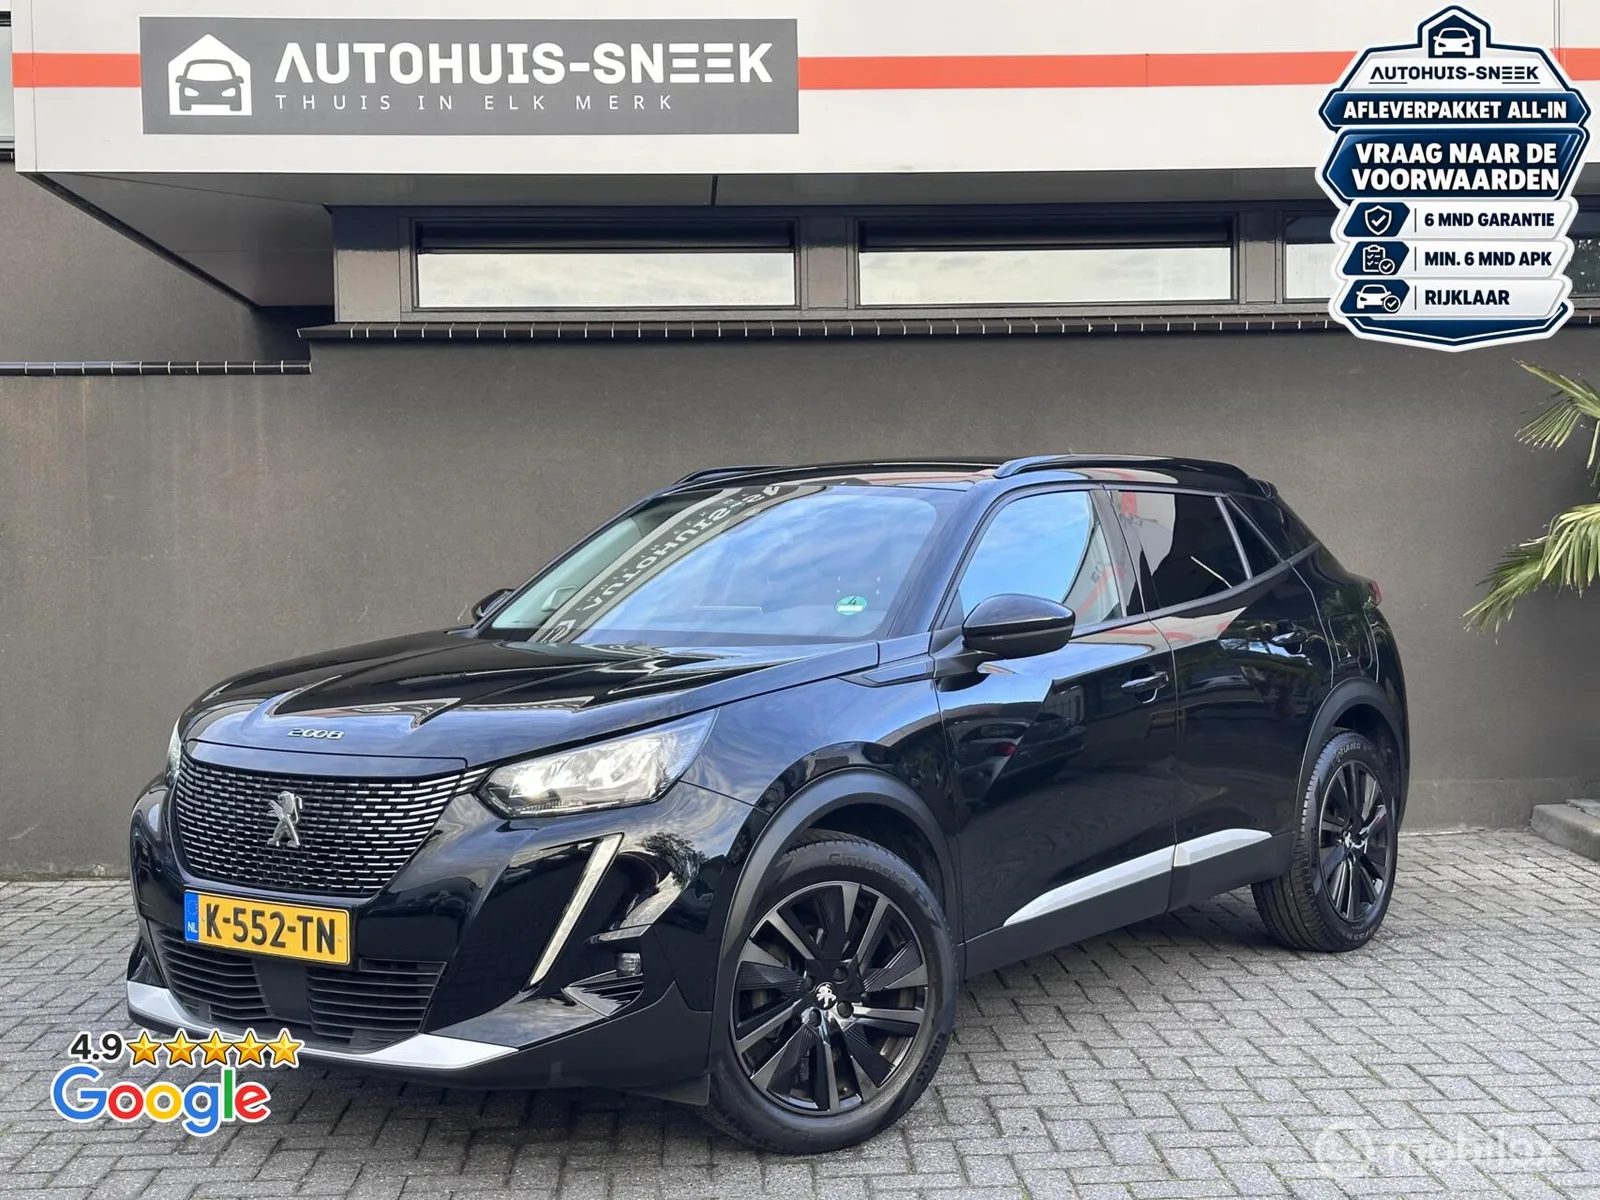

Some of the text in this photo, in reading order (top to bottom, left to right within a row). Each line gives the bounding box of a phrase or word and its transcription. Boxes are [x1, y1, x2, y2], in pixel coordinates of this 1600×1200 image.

[274, 42, 773, 85] AUTOHUIS-SNEEK
[275, 94, 673, 111] THUIS IN ELK MERK
[287, 727, 345, 740] 2008
[187, 902, 336, 955] NL K-552-TN
